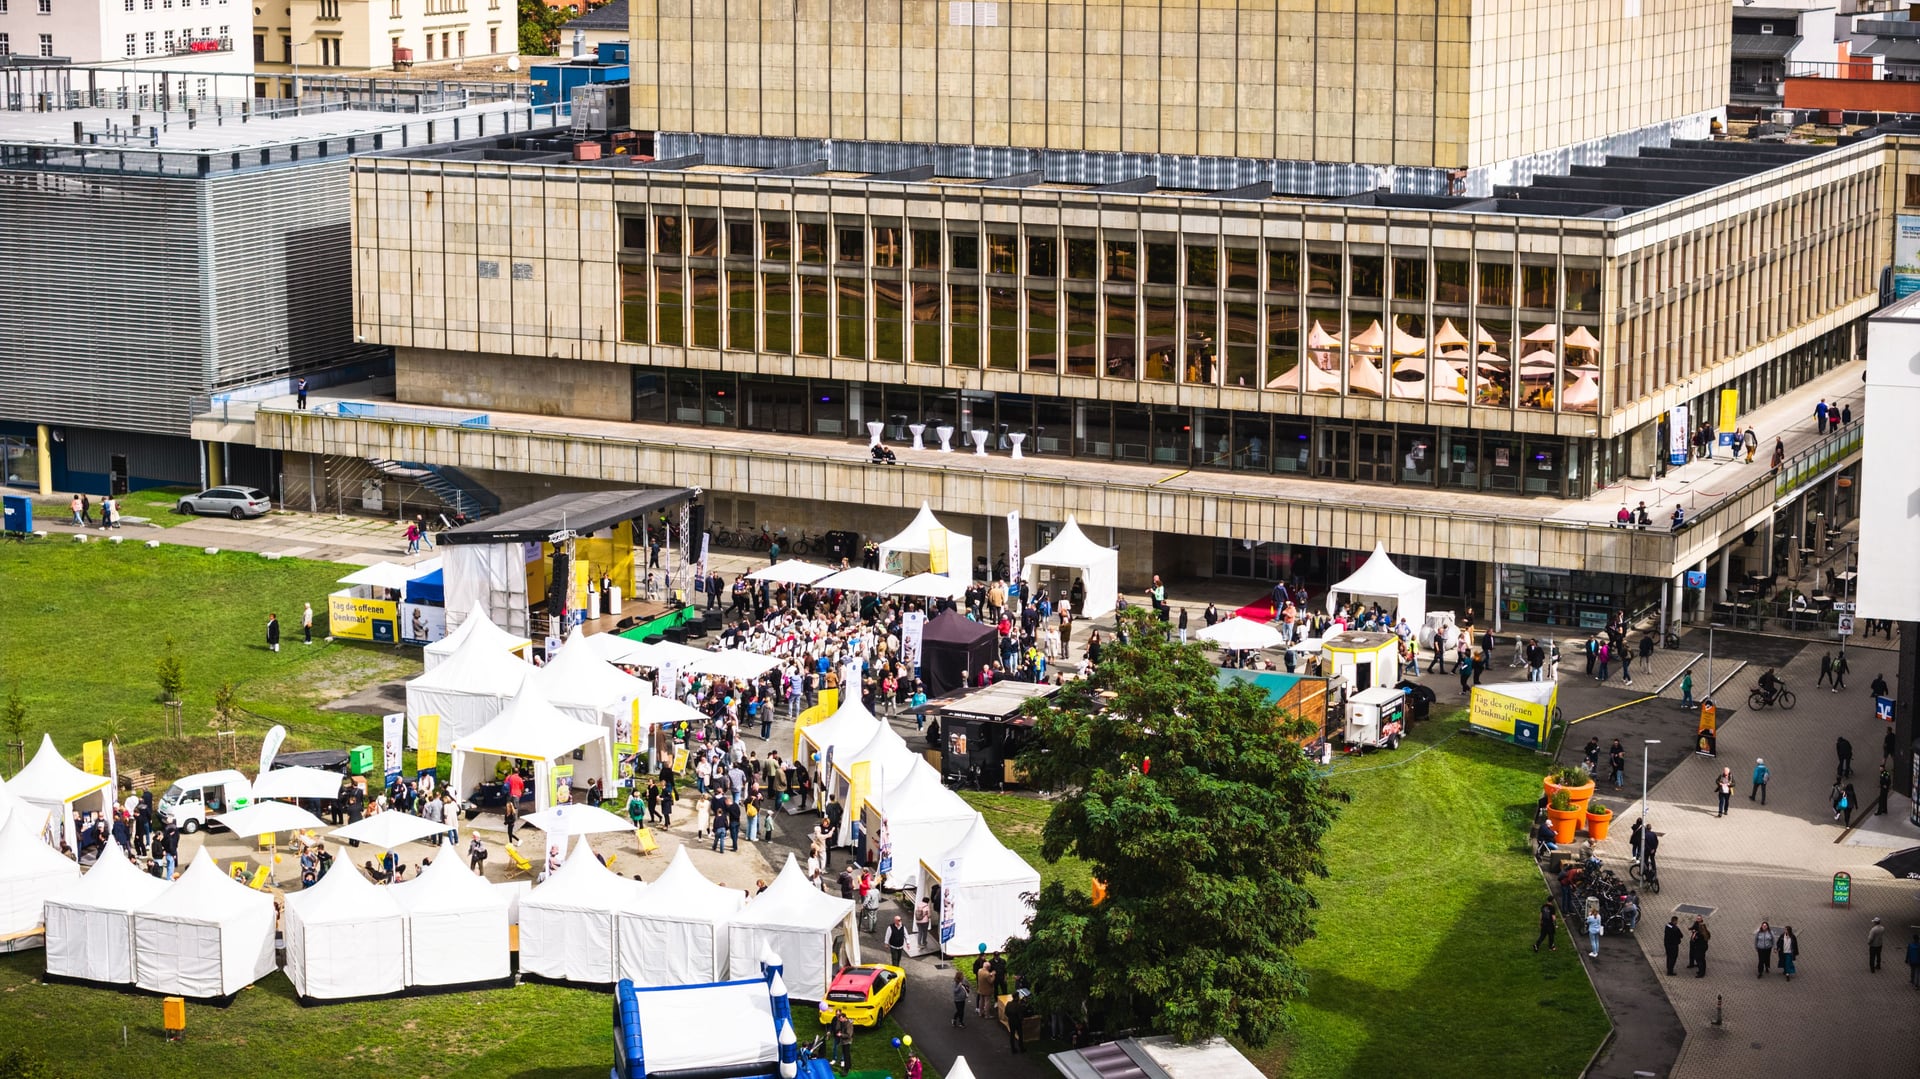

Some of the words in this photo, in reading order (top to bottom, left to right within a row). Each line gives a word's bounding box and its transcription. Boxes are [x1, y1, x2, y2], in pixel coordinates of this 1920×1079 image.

[333, 601, 344, 612] Tag
[346, 602, 357, 611] des
[359, 604, 384, 614] offenen
[1475, 694, 1488, 706] Tag
[1490, 698, 1502, 707] des
[1504, 703, 1532, 716] offenen
